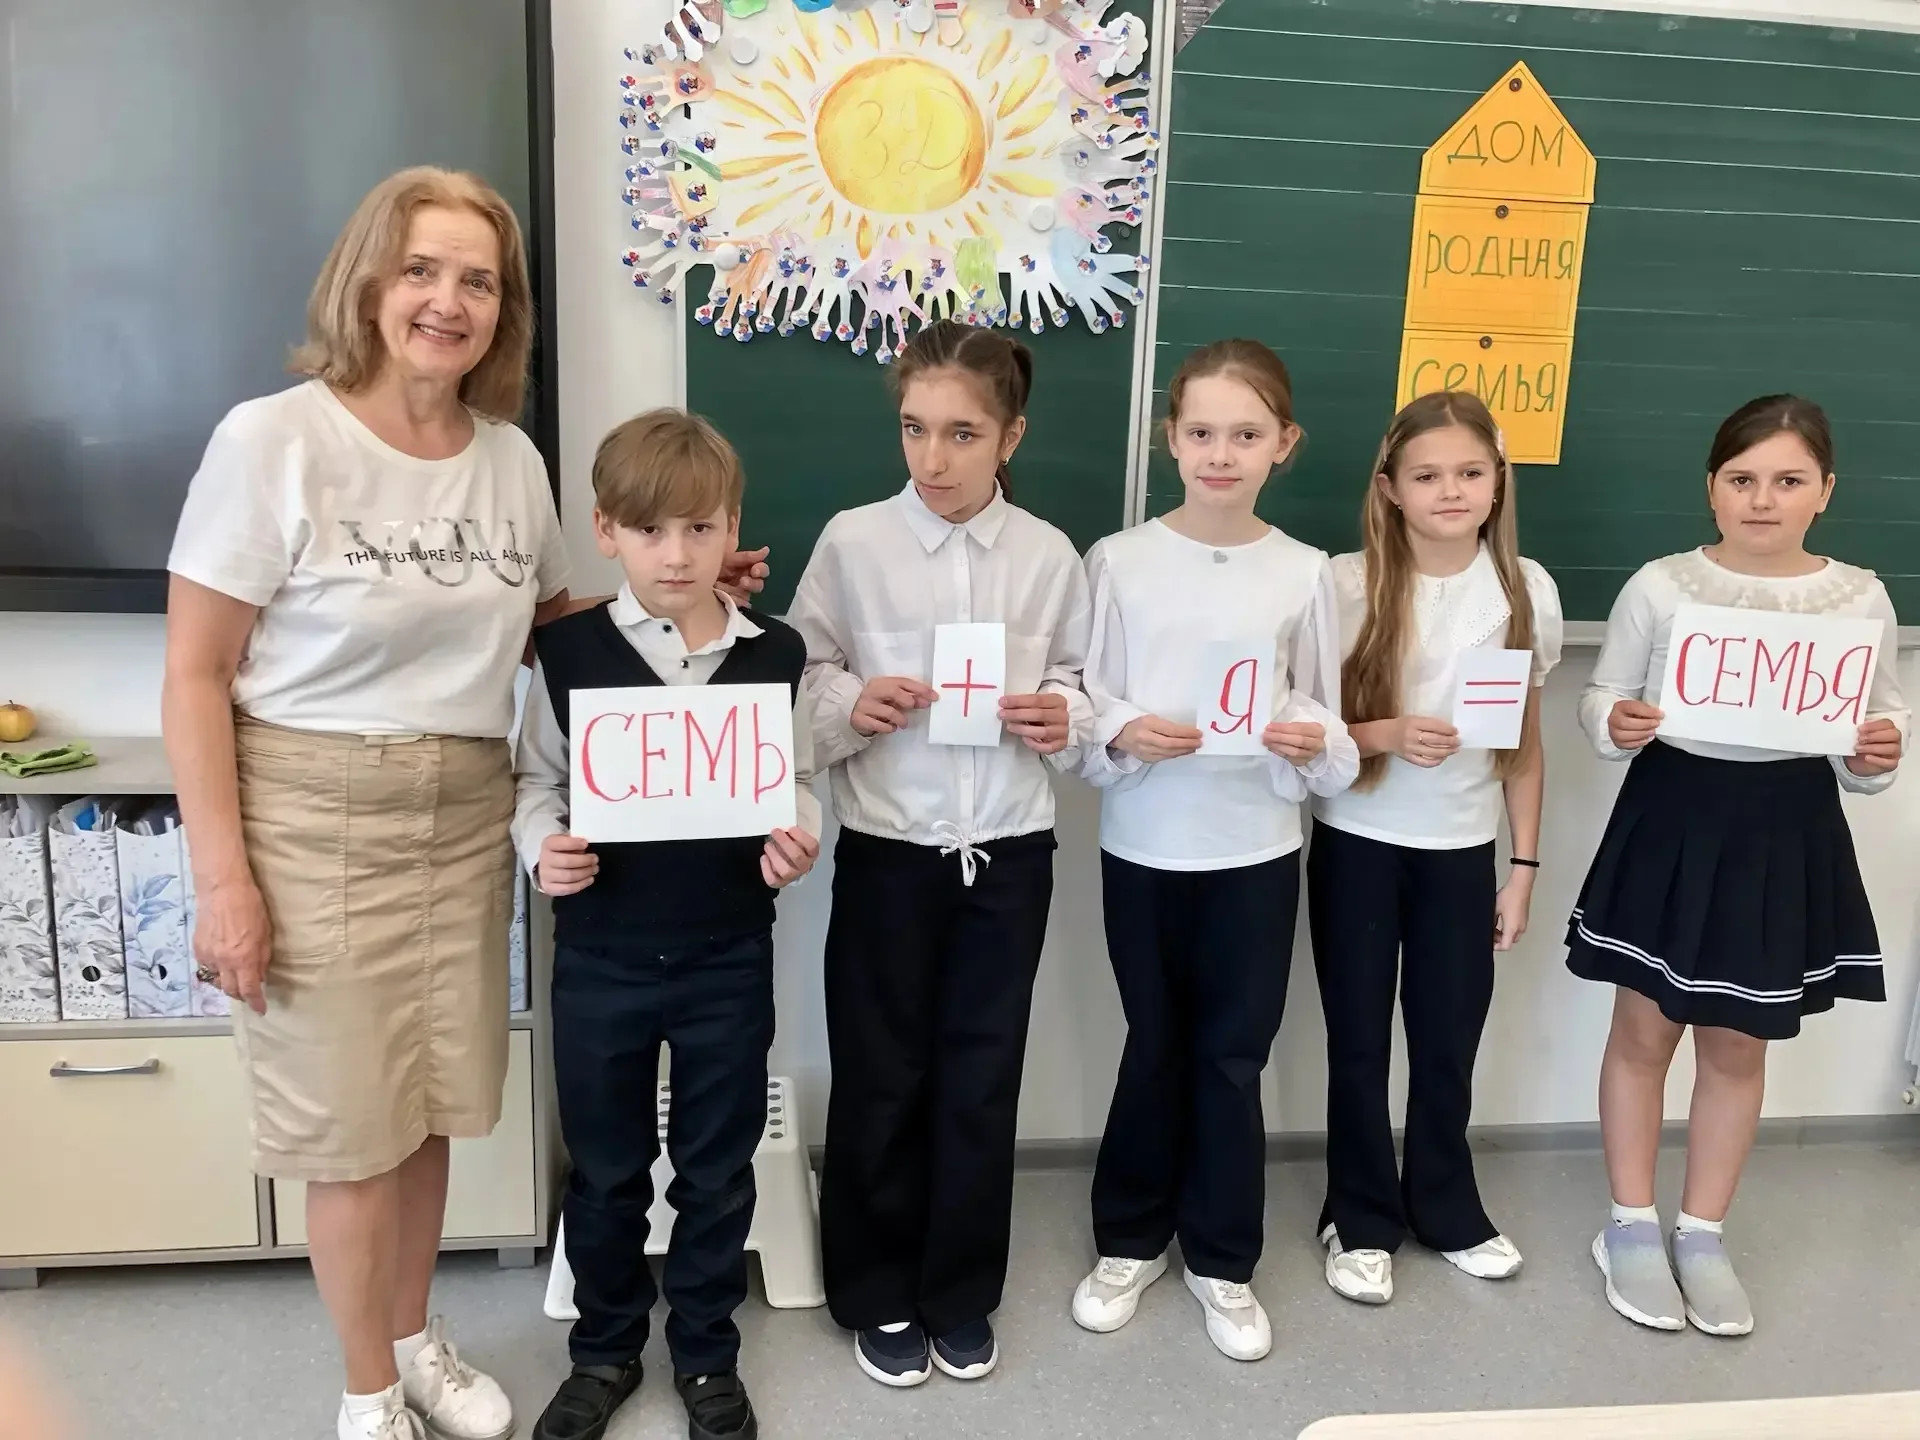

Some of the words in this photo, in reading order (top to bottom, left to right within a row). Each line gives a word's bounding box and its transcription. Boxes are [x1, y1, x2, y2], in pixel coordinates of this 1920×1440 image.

[1447, 121, 1564, 167] ДОМ
[338, 517, 525, 587] YOU
[344, 551, 377, 567] THE
[386, 549, 446, 563] FUTURE
[451, 551, 464, 563] IS
[470, 550, 497, 563] ALL
[503, 549, 534, 567] ABOUT
[940, 658, 998, 718] +
[1210, 658, 1258, 735] Я
[1675, 632, 1873, 725] СЕМЬЯ
[581, 703, 787, 804] СЕМЬ
